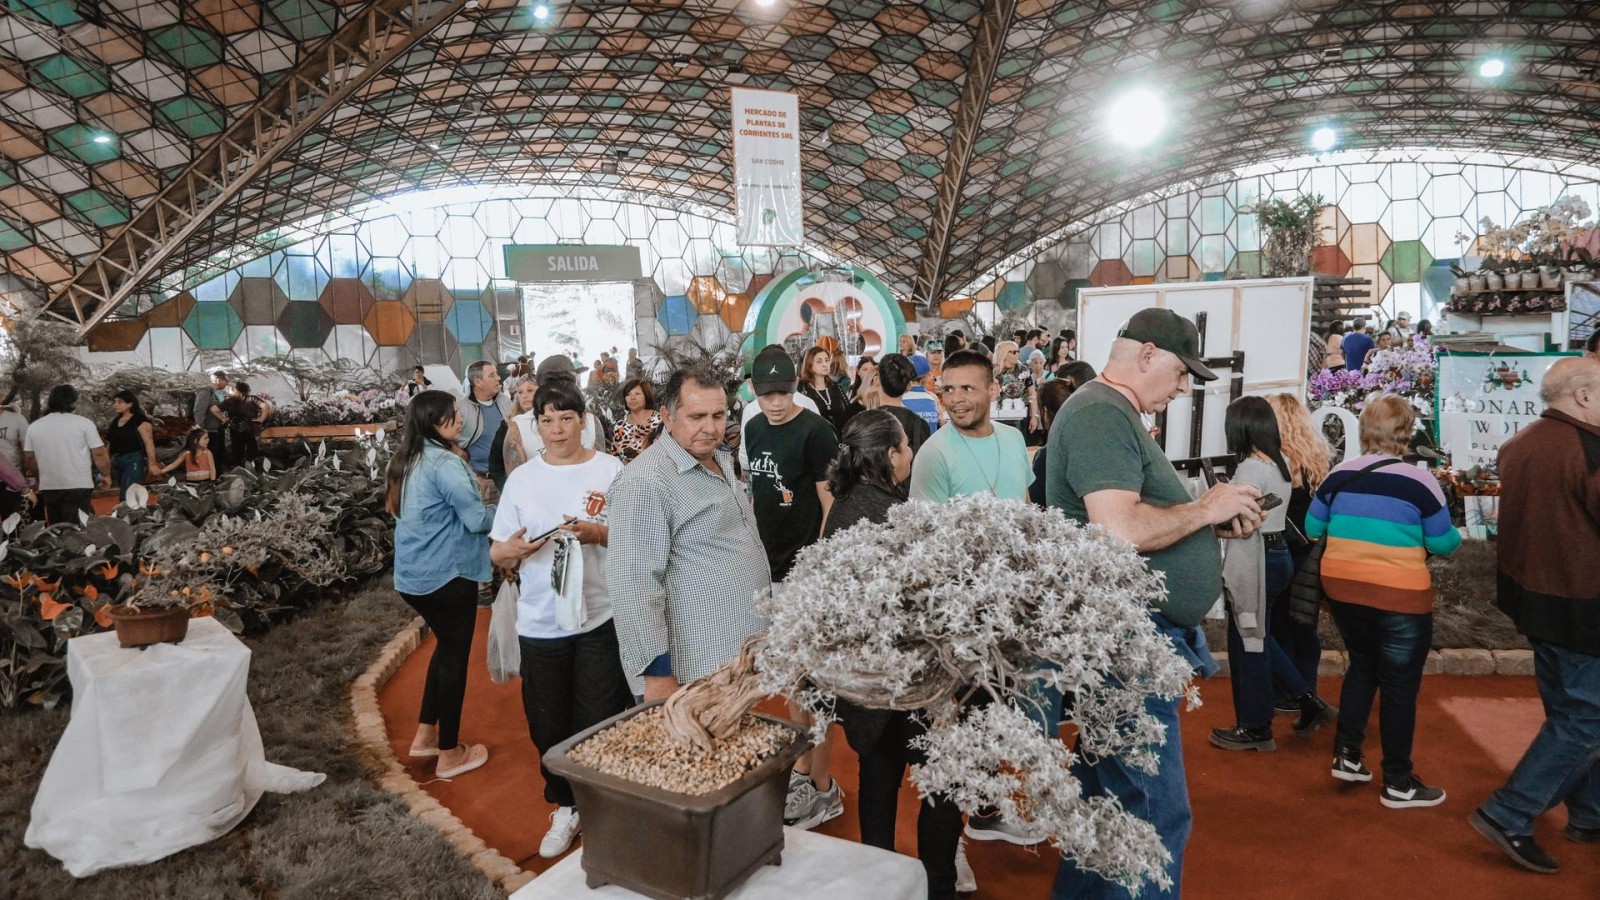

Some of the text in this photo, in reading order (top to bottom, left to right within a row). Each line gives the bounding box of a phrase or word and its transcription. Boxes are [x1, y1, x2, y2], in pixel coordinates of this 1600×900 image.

[744, 108, 777, 117] MERCADO
[746, 119, 776, 127] PLANTAS
[739, 129, 780, 138] CORRIENTES
[548, 255, 599, 271] SALIDA
